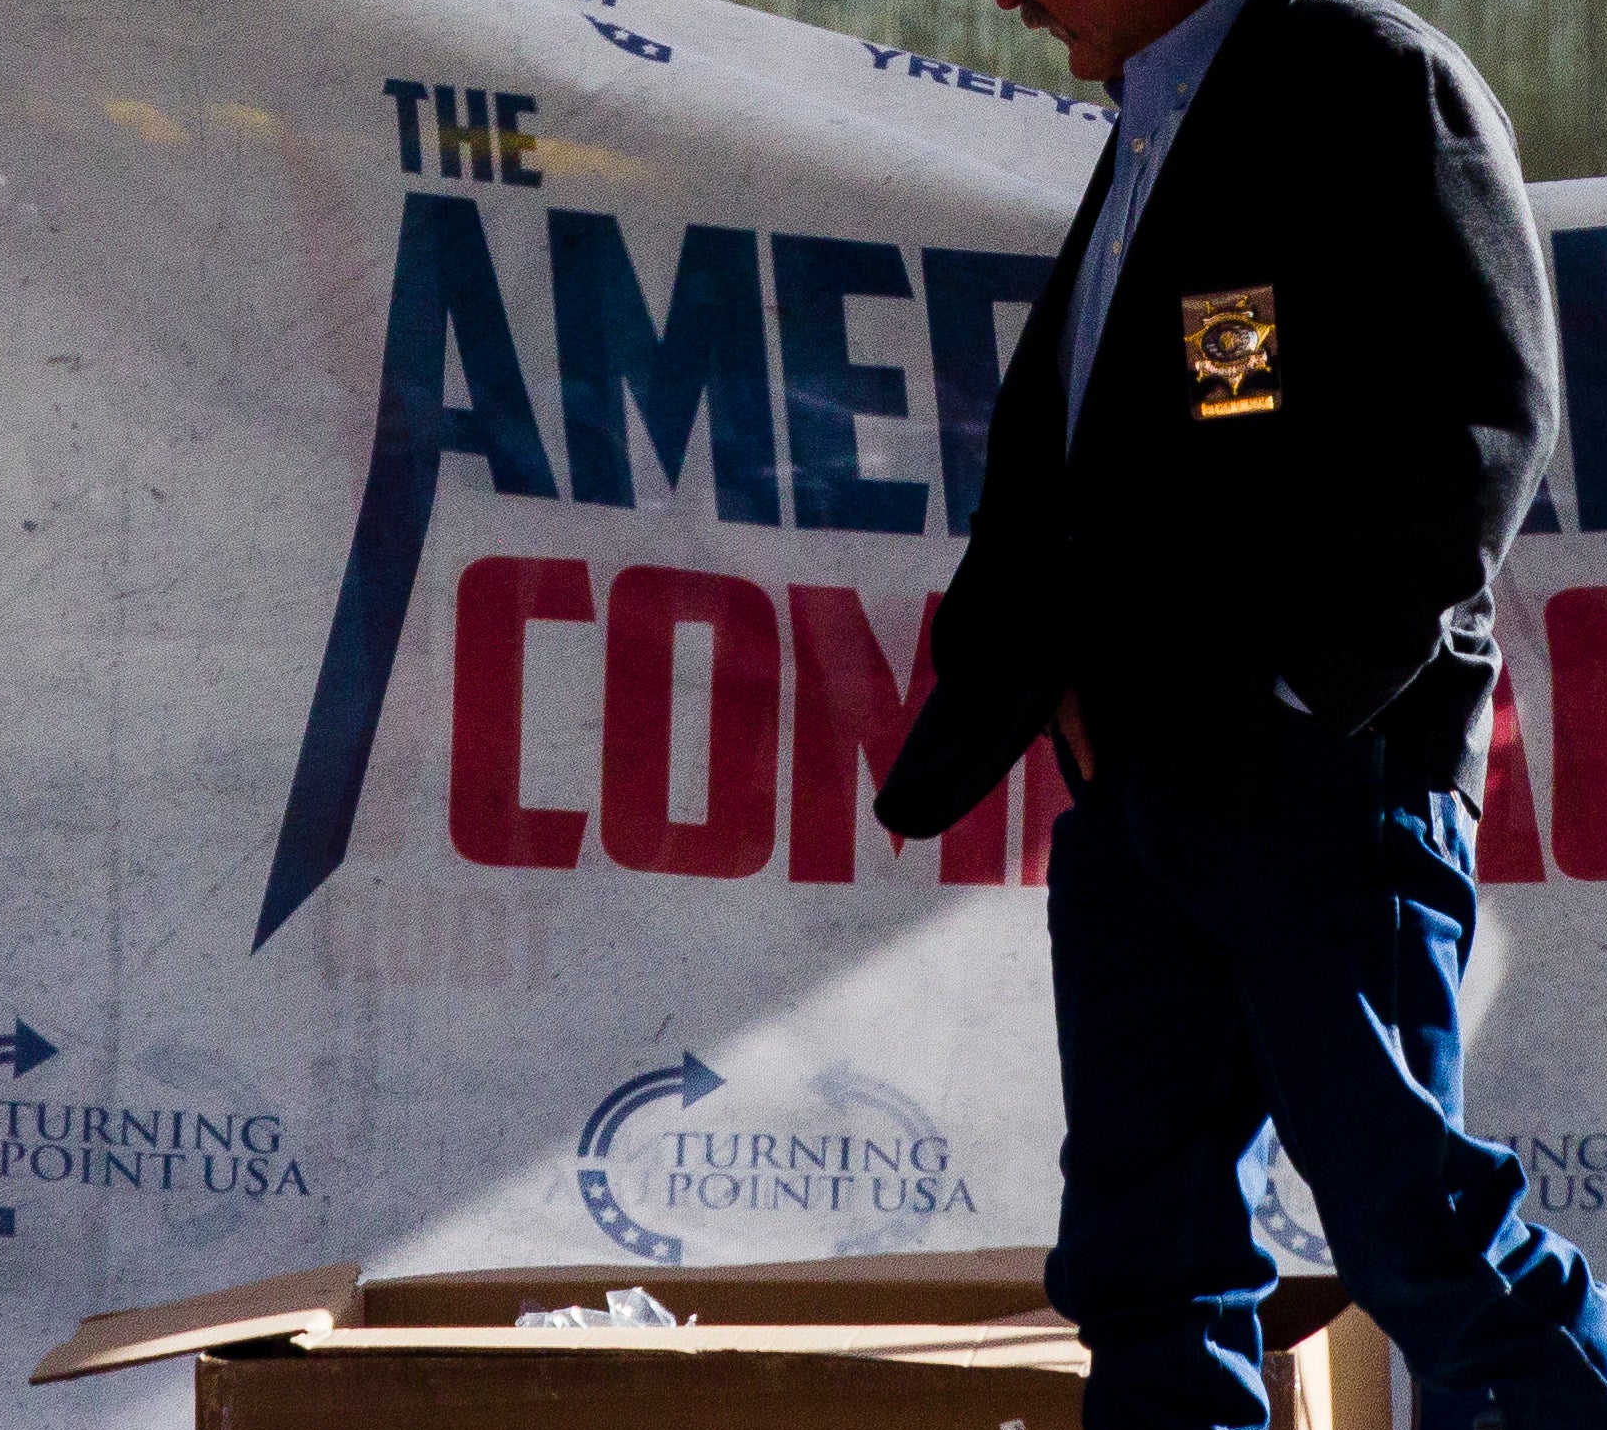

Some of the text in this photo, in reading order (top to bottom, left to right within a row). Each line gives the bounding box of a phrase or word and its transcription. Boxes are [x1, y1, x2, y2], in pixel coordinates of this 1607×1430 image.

[385, 77, 543, 188] THE
[663, 1131, 951, 1174] TURNING
[205, 1152, 313, 1200] USA
[665, 1172, 979, 1215] POINT USA
